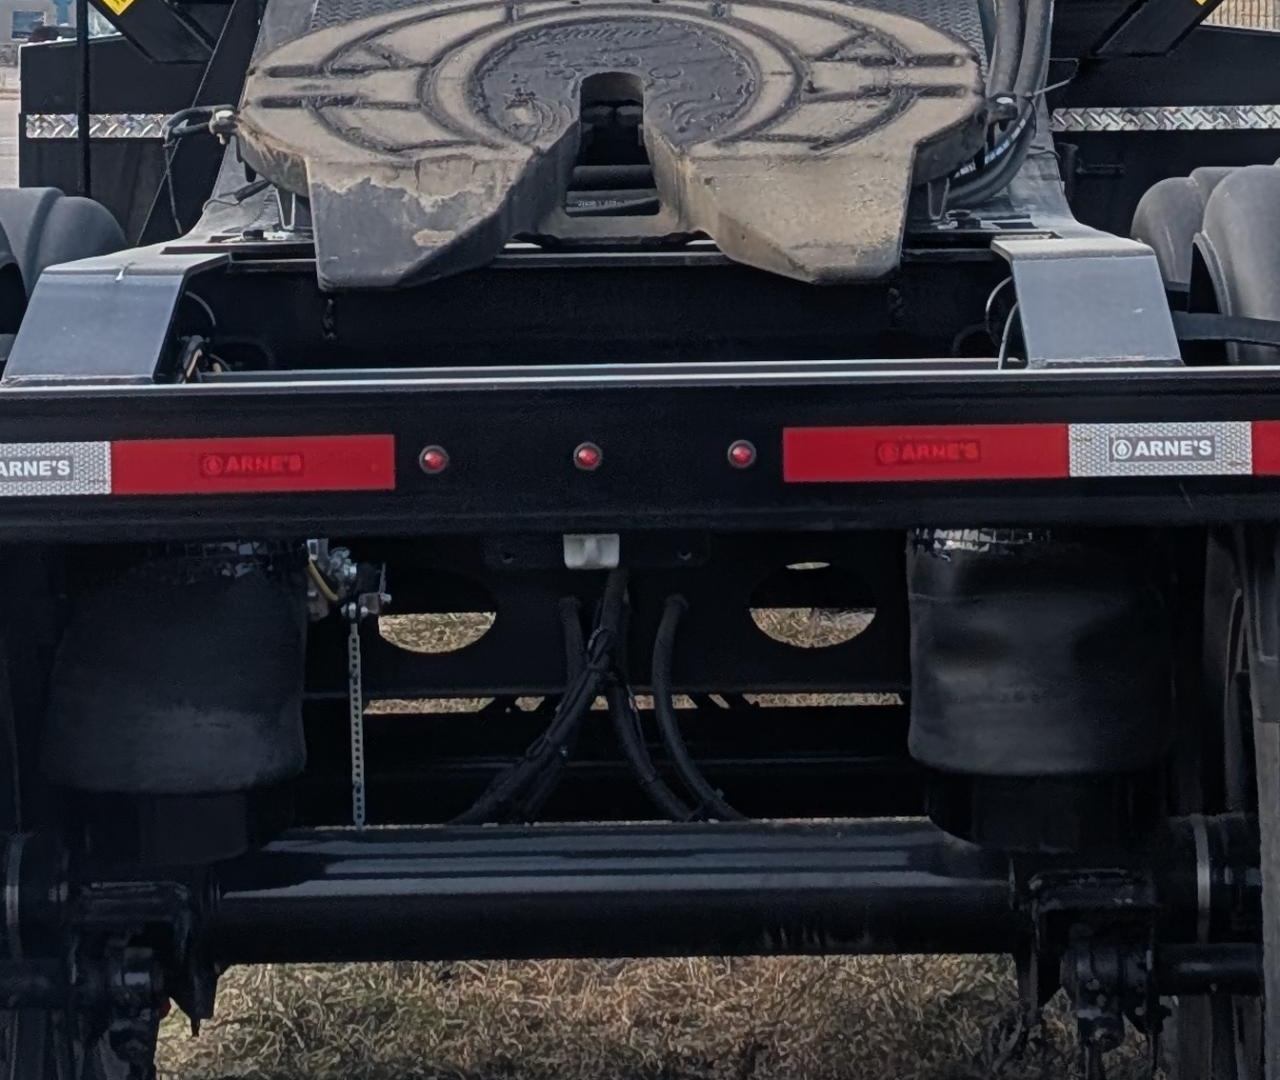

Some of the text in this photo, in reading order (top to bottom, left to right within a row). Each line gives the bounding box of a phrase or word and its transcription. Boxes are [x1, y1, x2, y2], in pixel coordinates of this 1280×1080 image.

[902, 440, 978, 460] ARNE'S
[1134, 439, 1213, 457] ARNE'S
[226, 454, 302, 472] ARNE'S
